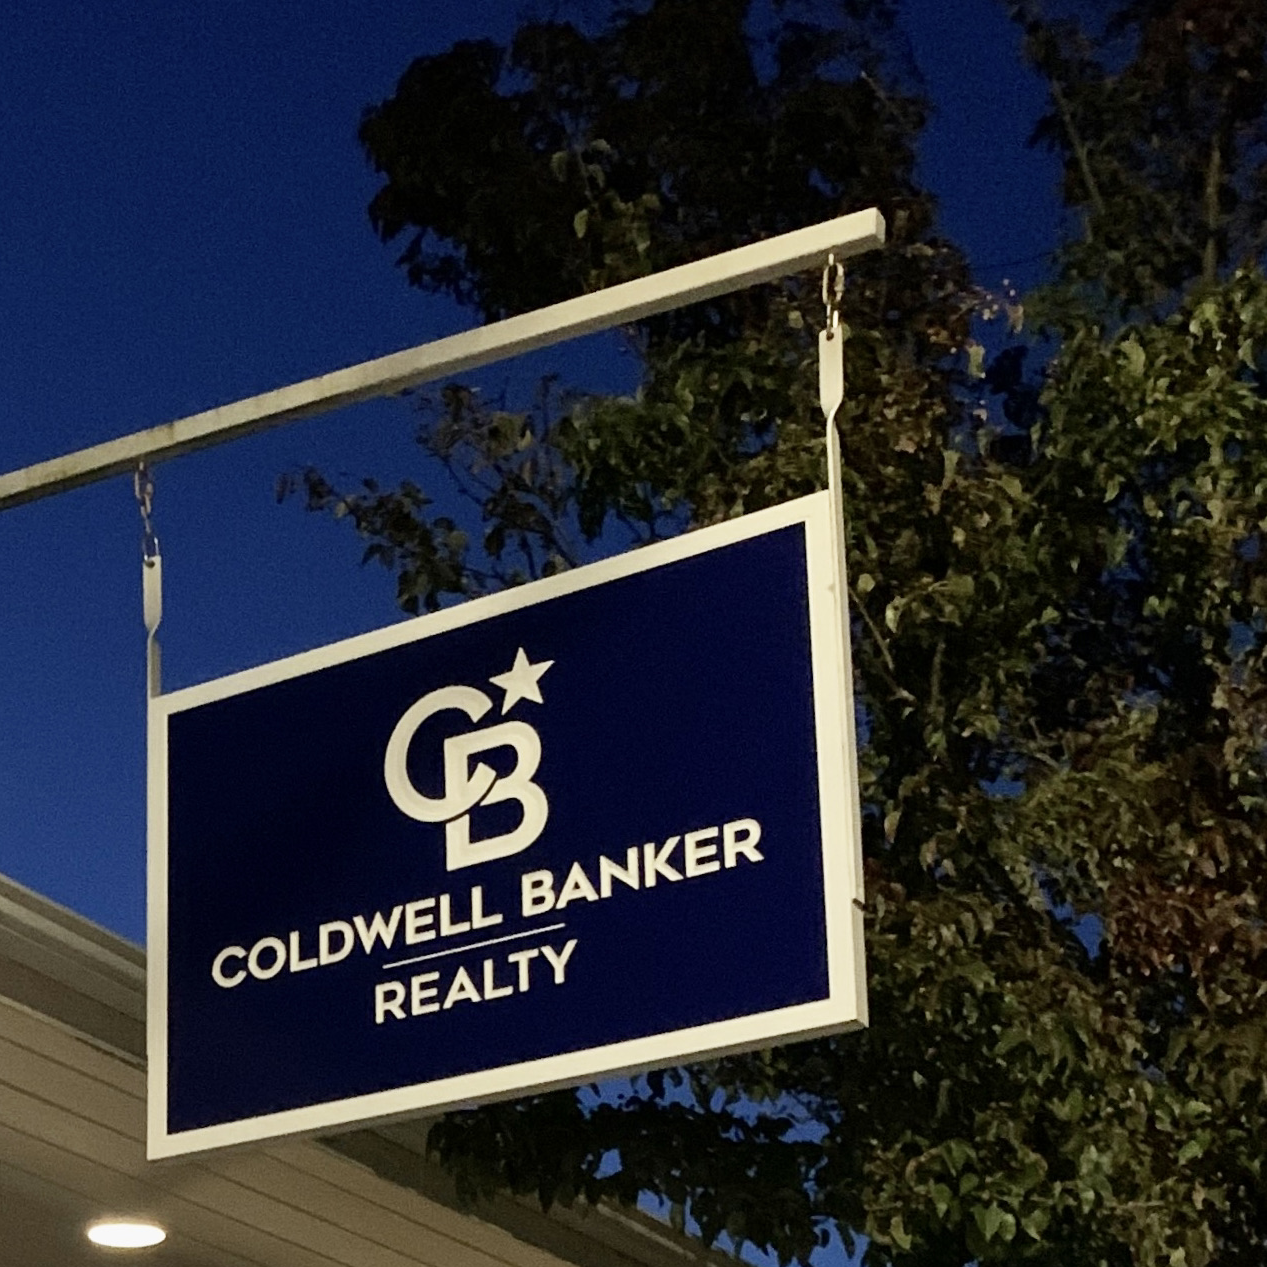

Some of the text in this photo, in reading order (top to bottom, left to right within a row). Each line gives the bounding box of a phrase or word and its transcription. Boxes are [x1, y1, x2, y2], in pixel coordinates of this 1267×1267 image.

[384, 685, 549, 872] CB
[211, 818, 765, 988] COLDWELL BANKER
[375, 938, 578, 1024] REALTY
